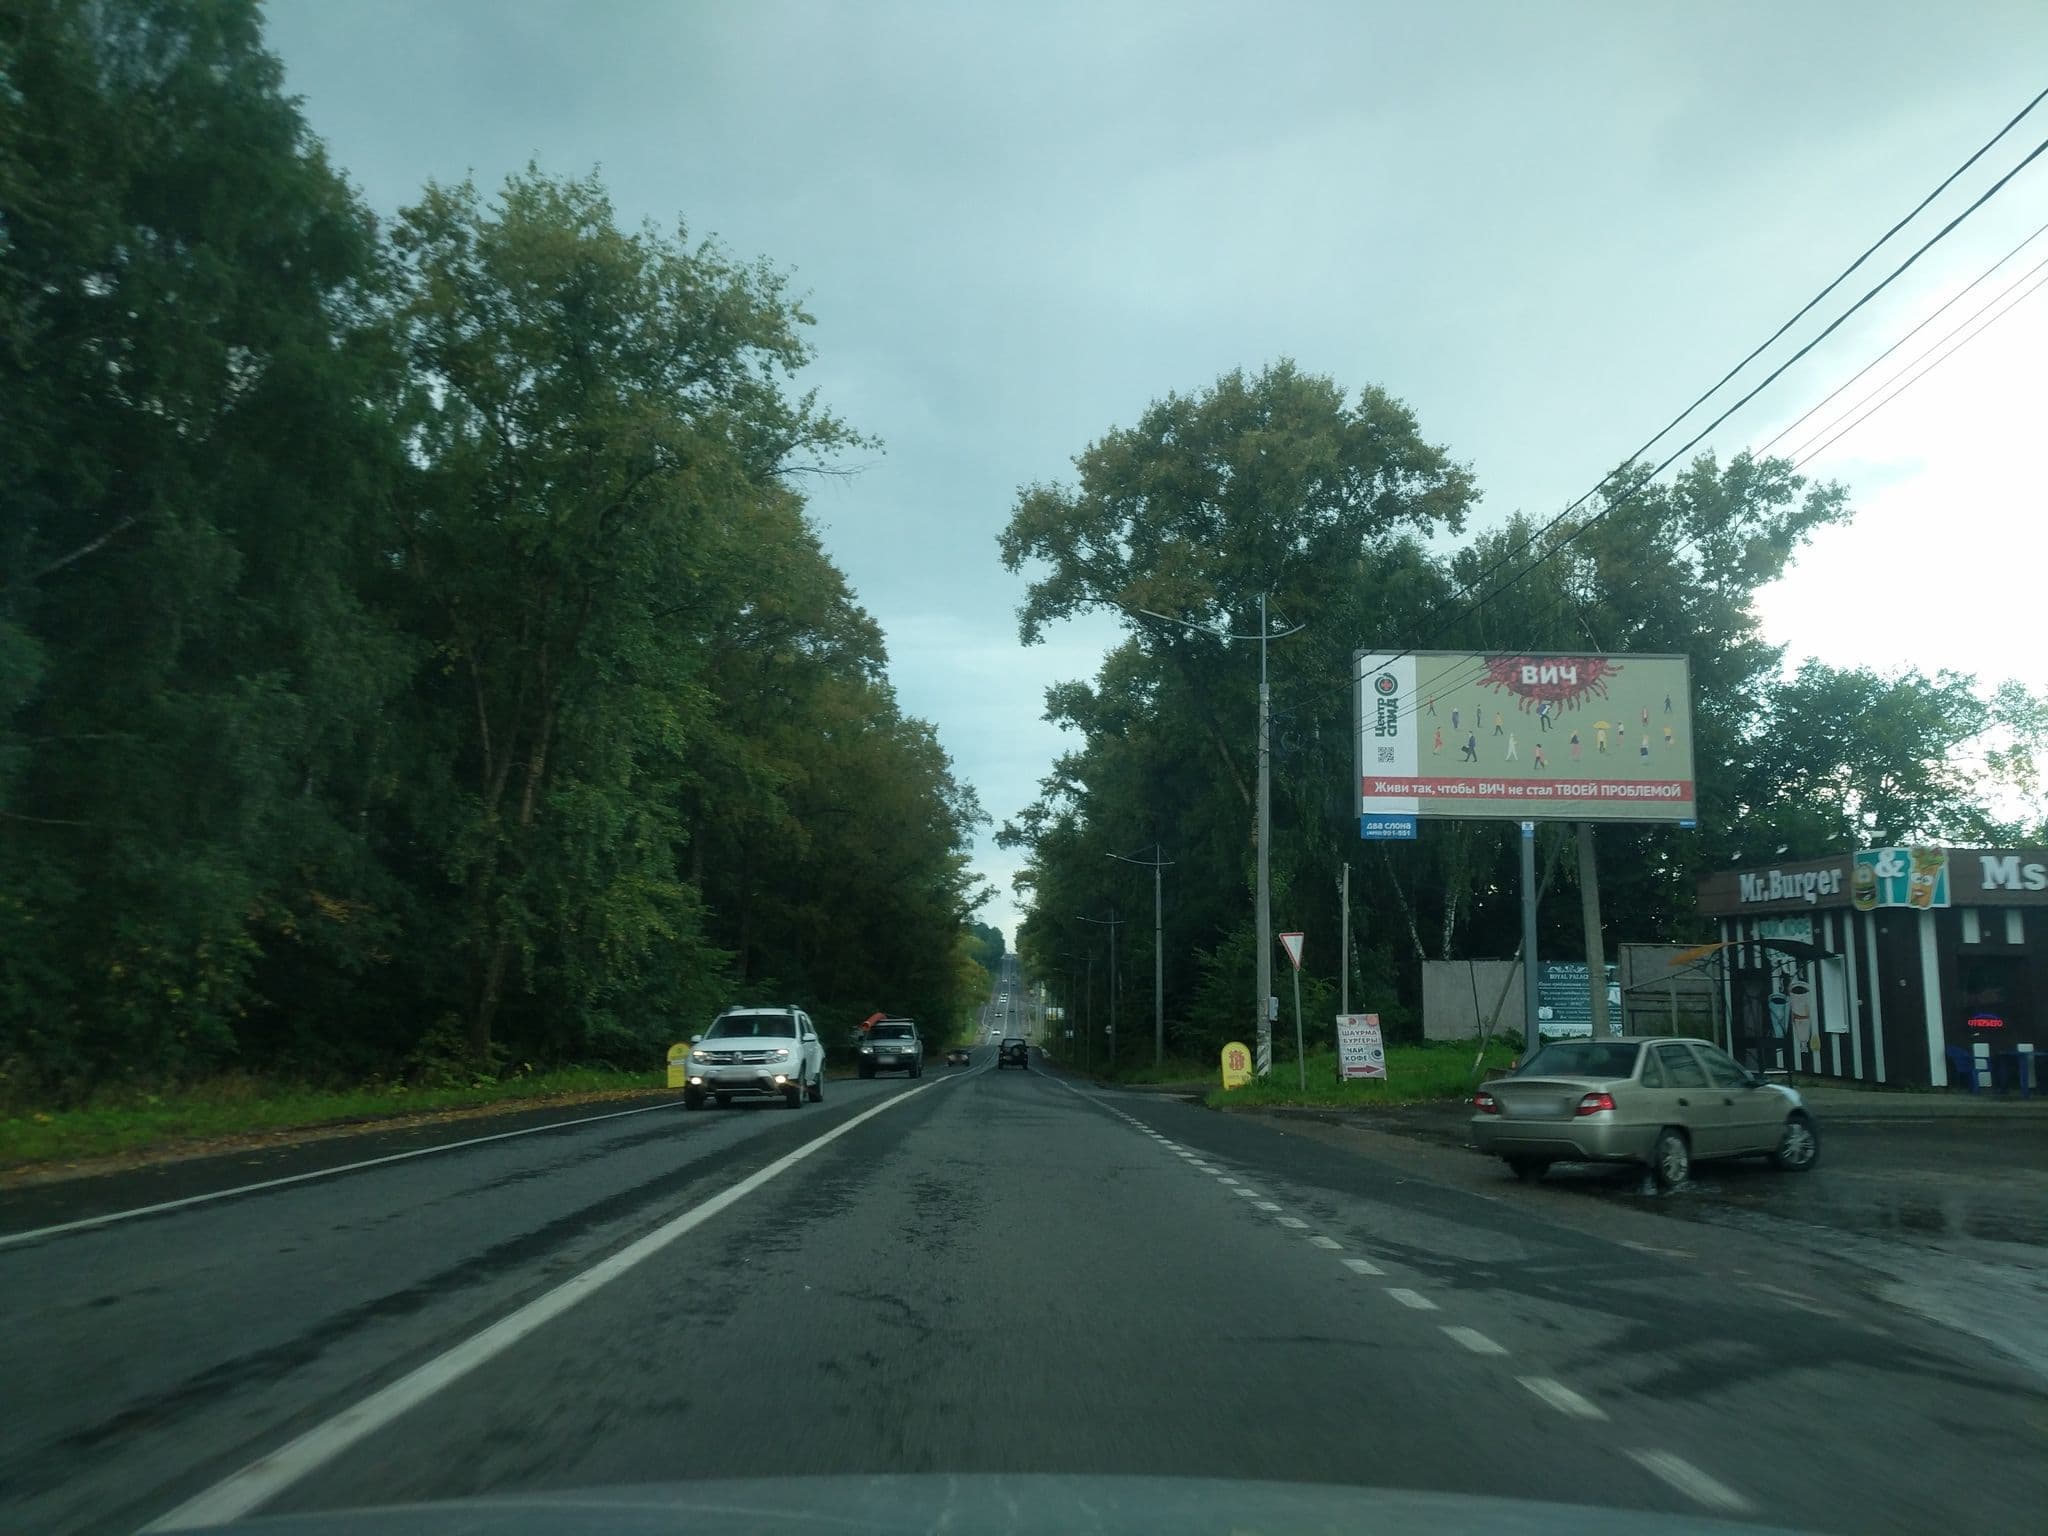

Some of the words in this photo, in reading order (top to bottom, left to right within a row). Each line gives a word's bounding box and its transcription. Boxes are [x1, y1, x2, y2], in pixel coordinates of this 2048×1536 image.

[1522, 665, 1577, 685] ВИЧ
[1375, 697, 1386, 737] Центр
[1387, 697, 1399, 737] СПИД
[1375, 781, 1409, 793] Живи
[1412, 784, 1436, 795] так,
[1437, 783, 1476, 795] чтобы
[1479, 783, 1504, 795] ВИЧ
[1508, 786, 1523, 795] не
[1526, 786, 1552, 795] стал
[1555, 783, 1598, 796] ТВОЕЙ
[1601, 784, 1681, 797] ПРОБЛЕМОЙ
[1739, 868, 1842, 904] Mr.Burger
[1874, 849, 1906, 877] &
